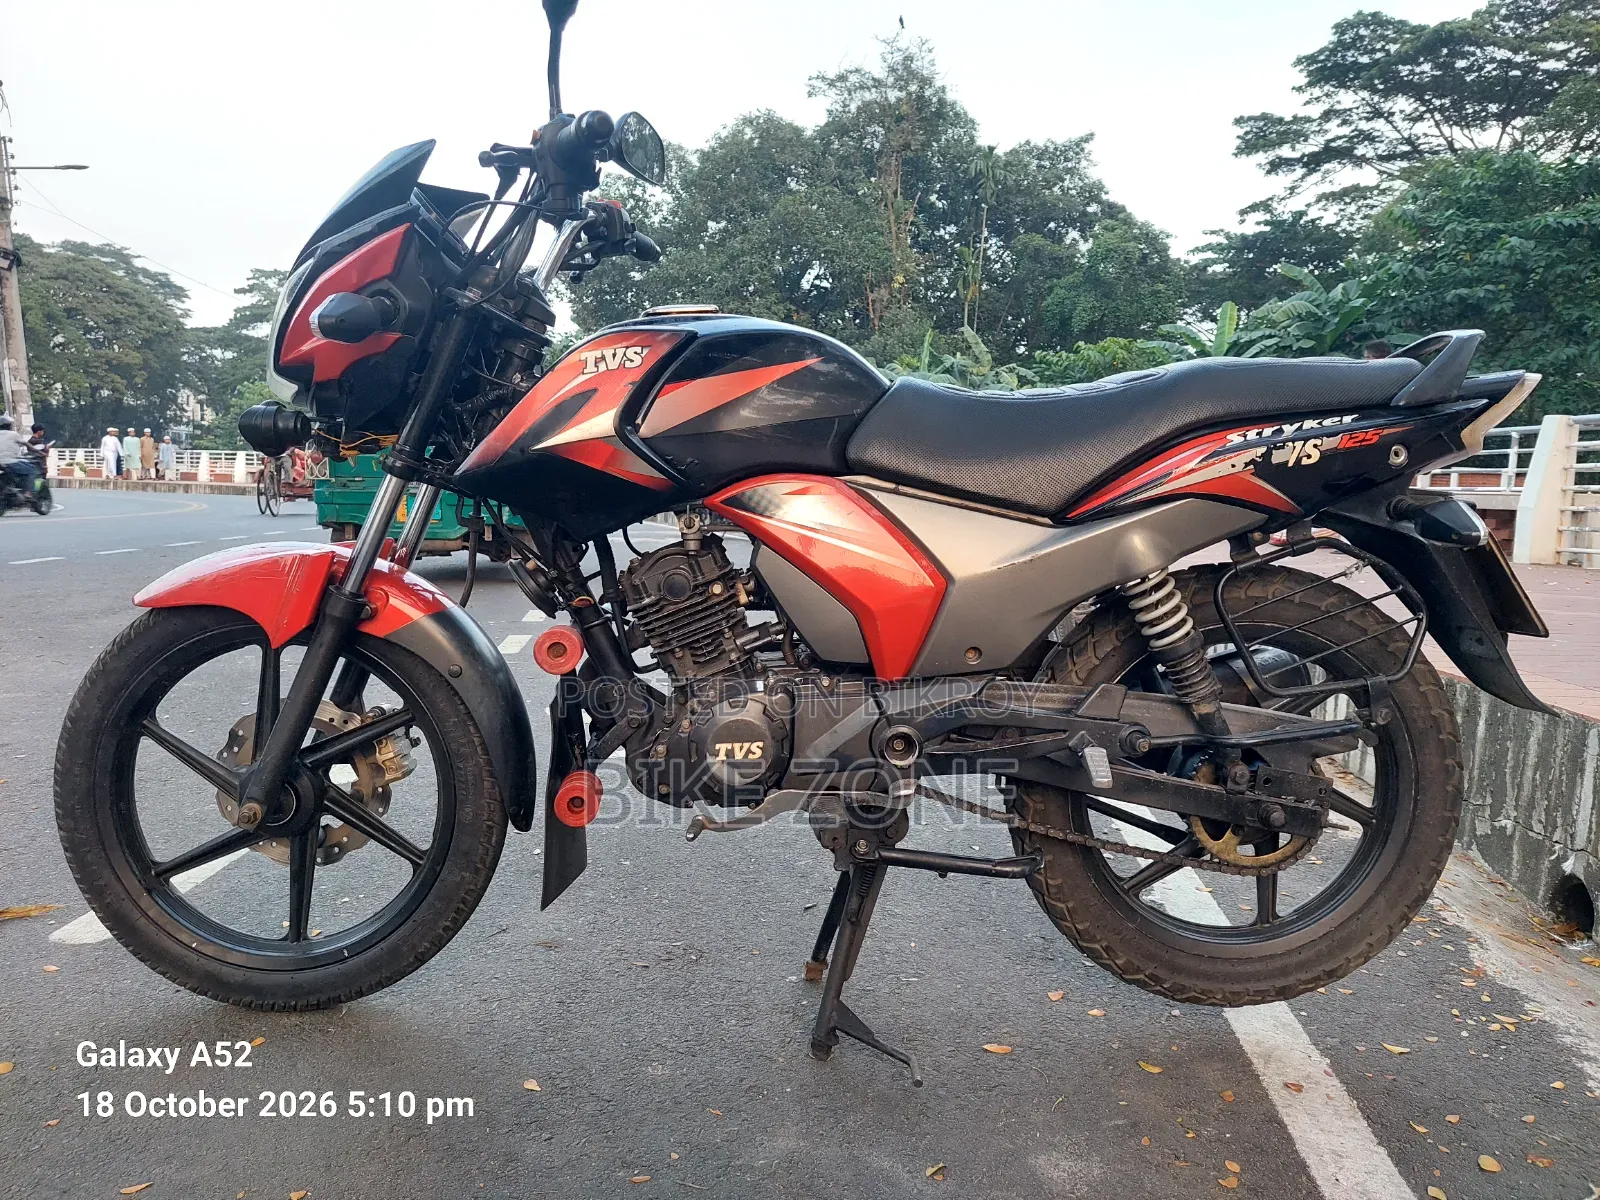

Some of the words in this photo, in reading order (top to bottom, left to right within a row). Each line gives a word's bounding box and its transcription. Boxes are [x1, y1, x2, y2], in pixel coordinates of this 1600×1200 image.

[580, 346, 643, 374] TVS
[1337, 429, 1384, 449] 125
[714, 741, 764, 761] TVS
